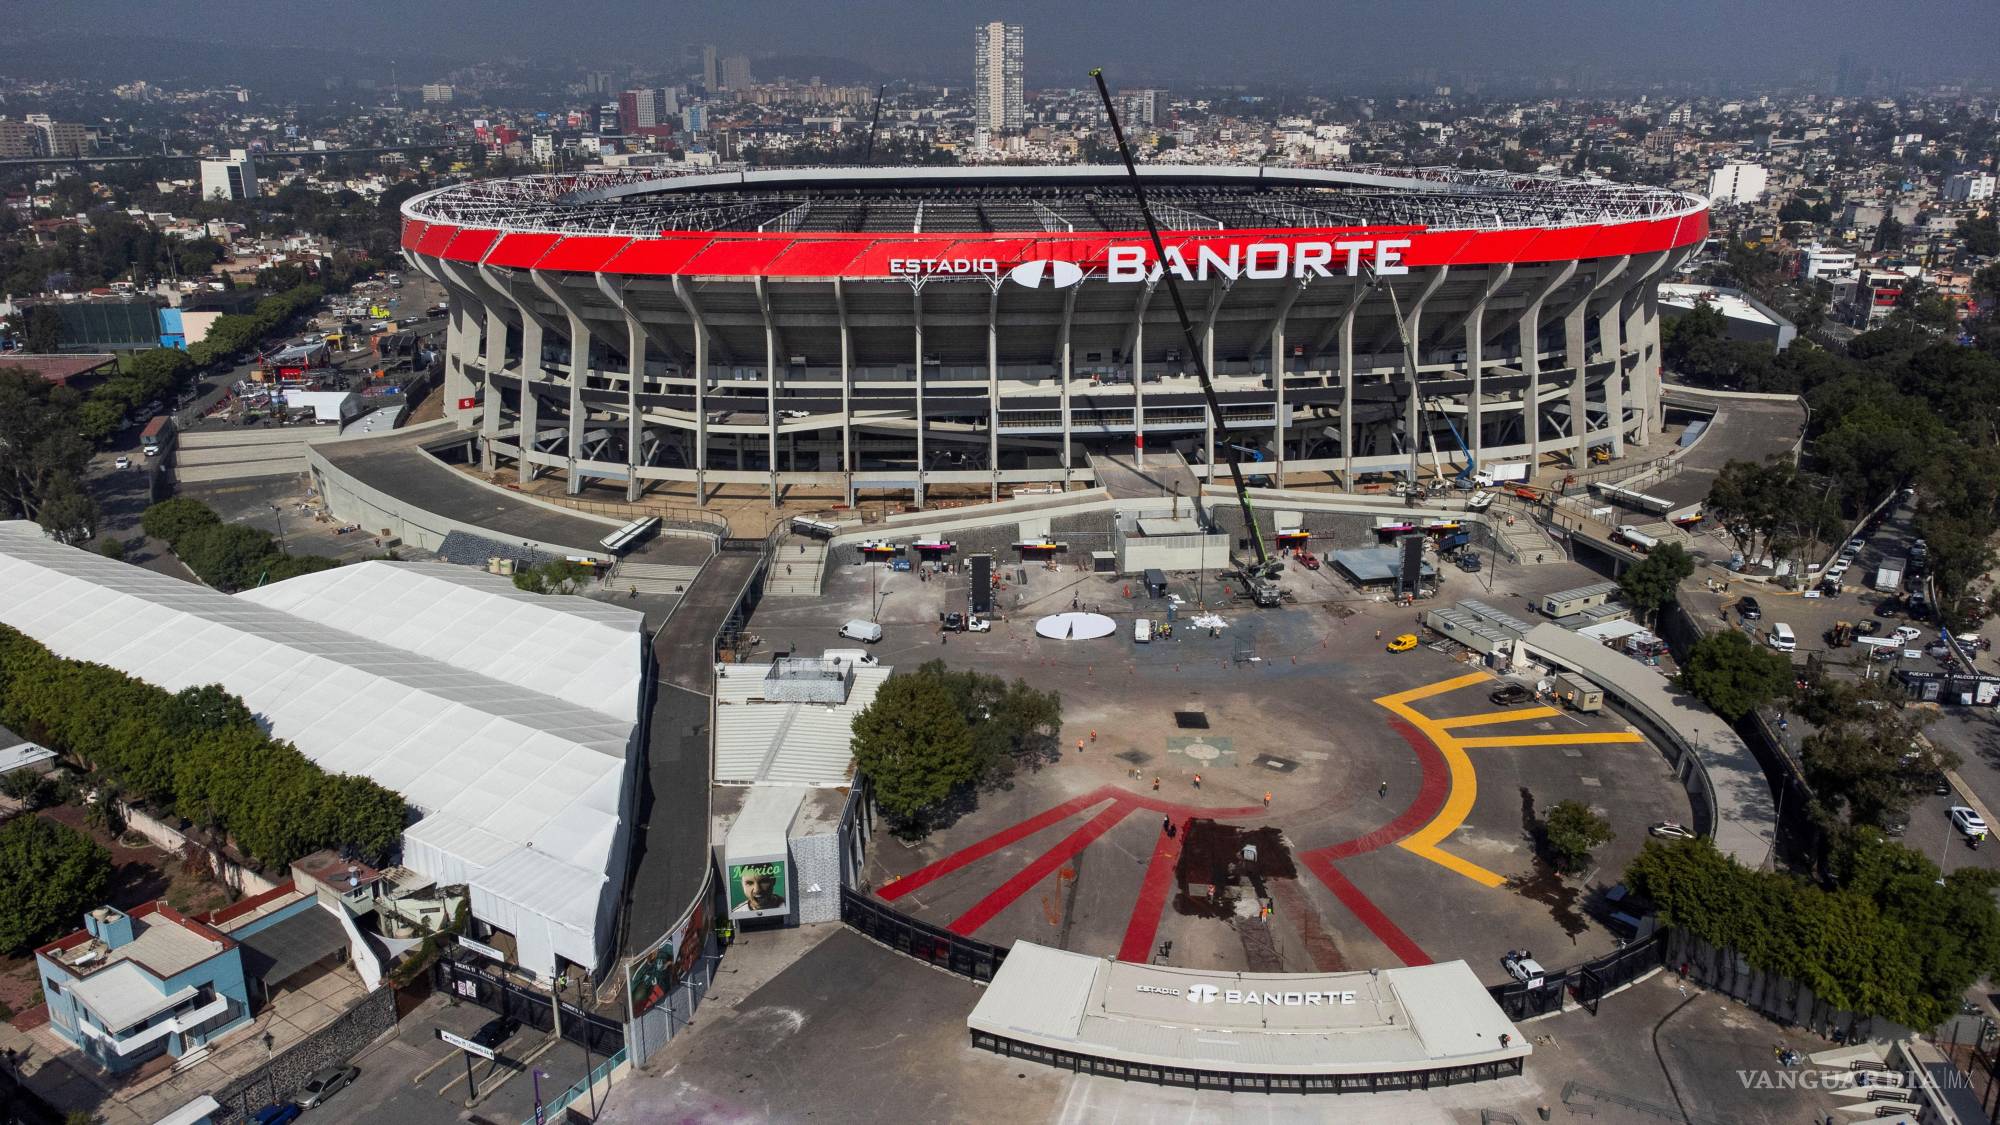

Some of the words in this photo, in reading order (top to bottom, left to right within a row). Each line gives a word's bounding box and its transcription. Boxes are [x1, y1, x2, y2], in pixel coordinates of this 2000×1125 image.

[890, 258, 997, 274] ESTADIO
[1107, 240, 1411, 283] BANORTE
[732, 863, 780, 879] México
[1136, 985, 1180, 996] ESTADIO
[1224, 989, 1357, 1006] BANORTE
